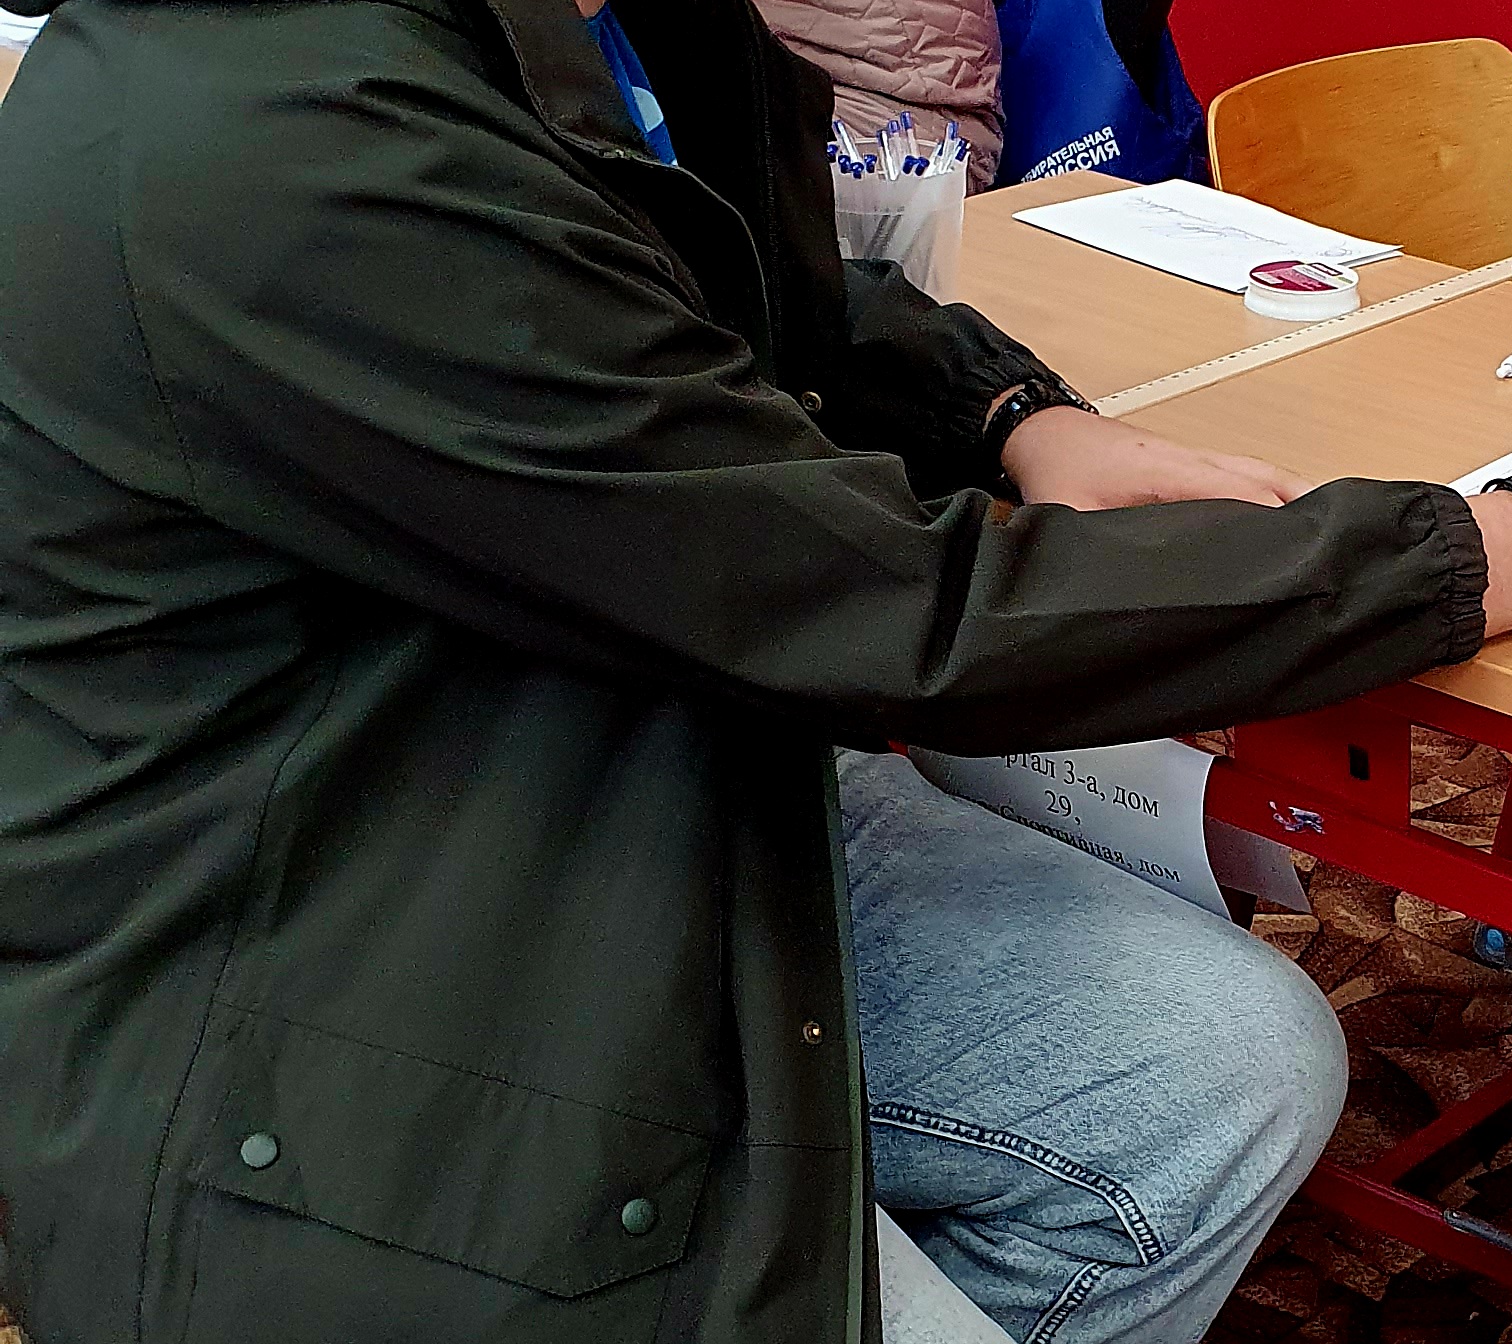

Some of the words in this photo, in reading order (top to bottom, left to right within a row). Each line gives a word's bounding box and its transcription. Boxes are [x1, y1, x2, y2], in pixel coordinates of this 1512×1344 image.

[1001, 754, 1055, 778] ртал
[1113, 786, 1160, 818] дом
[1138, 858, 1181, 883] дом
